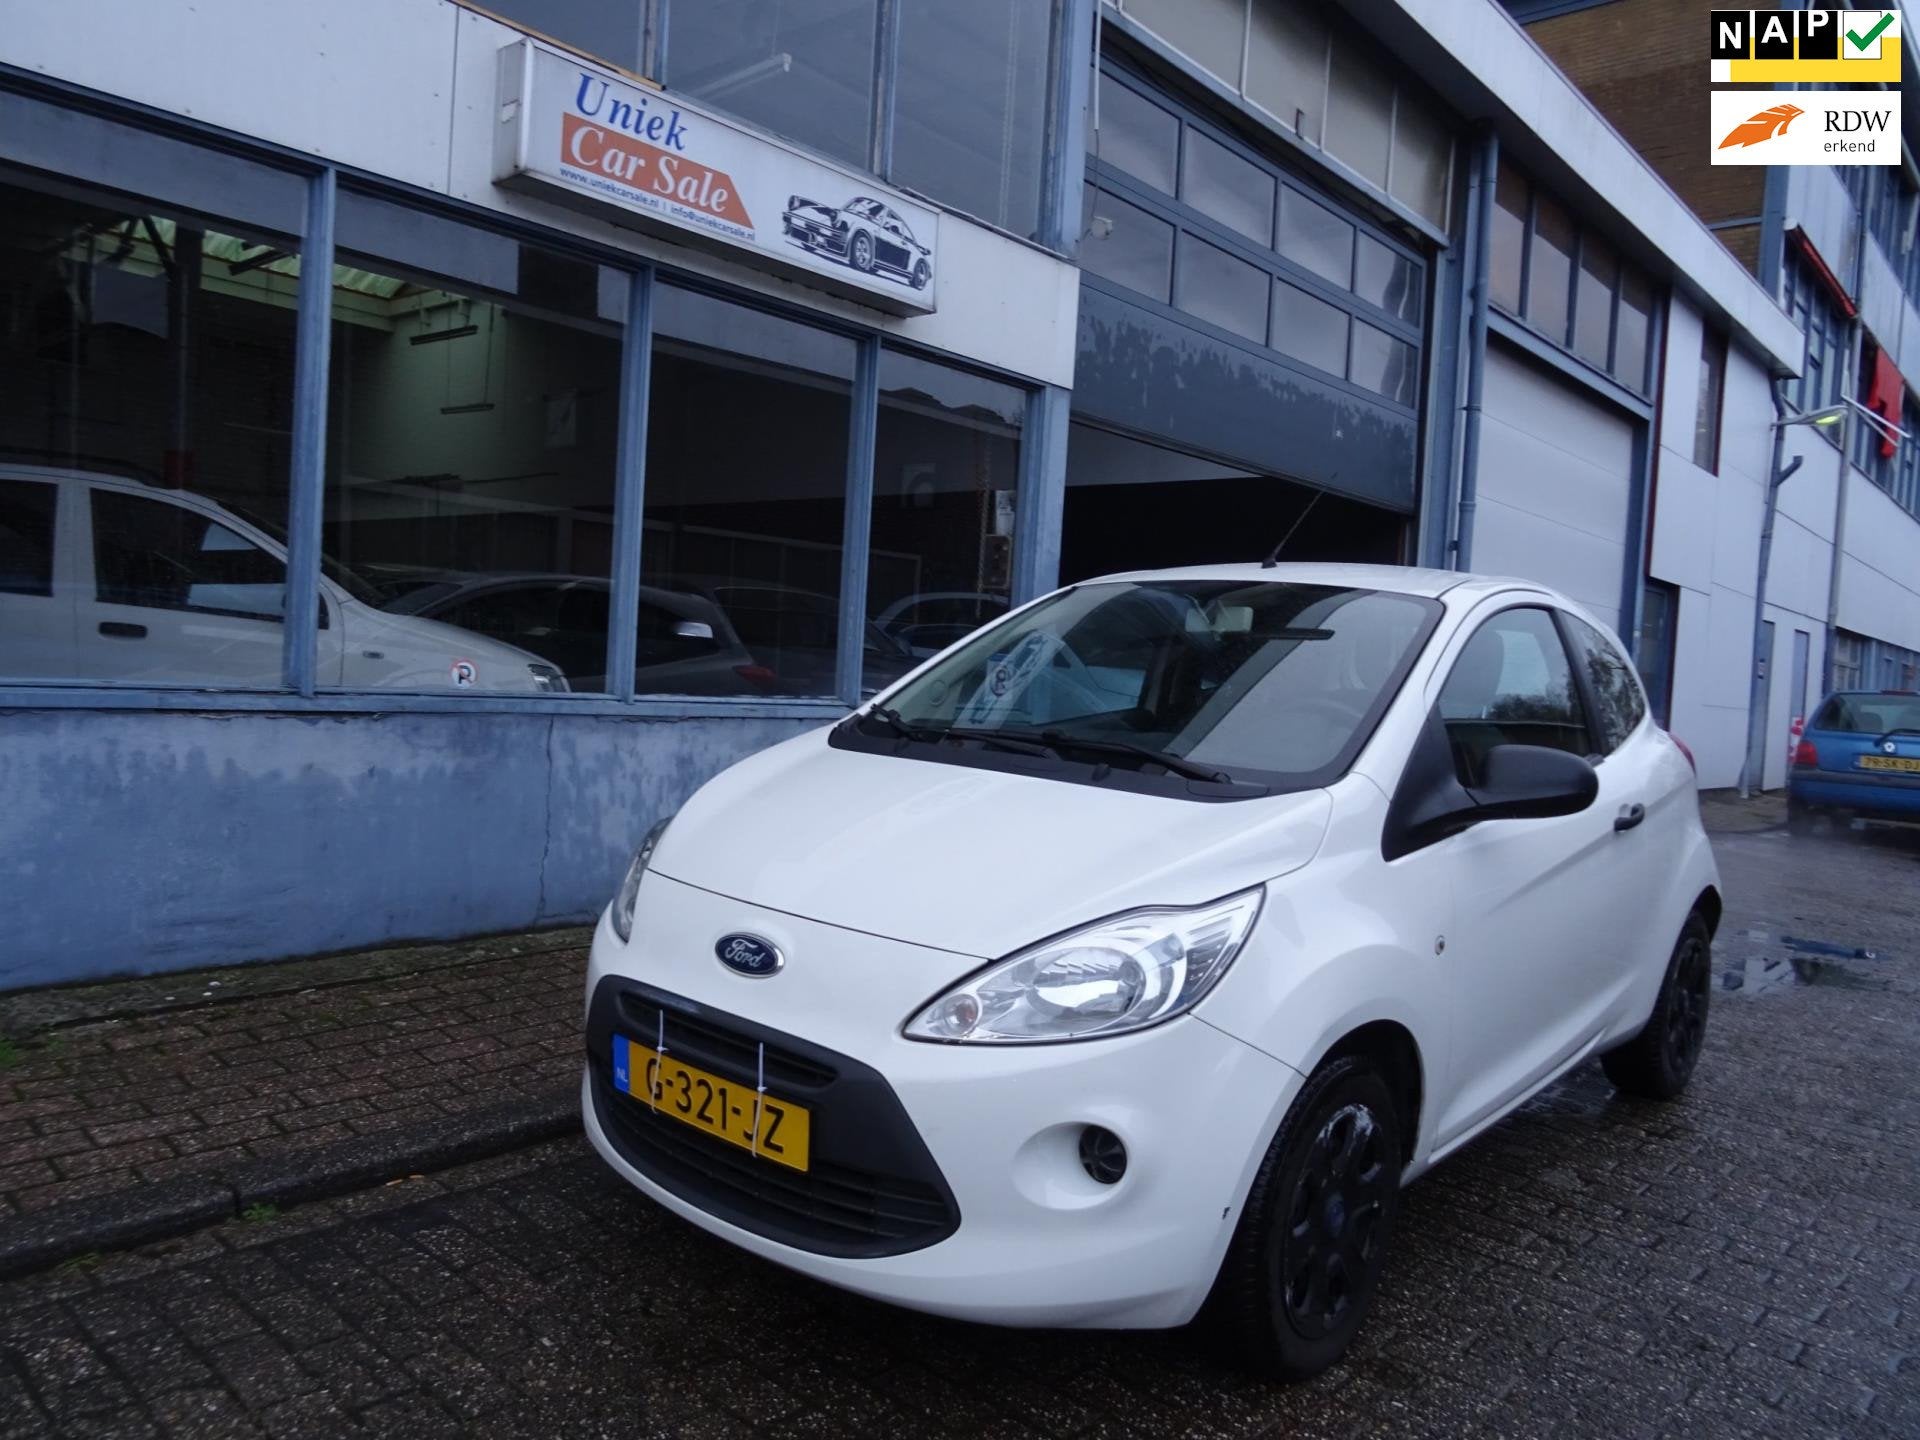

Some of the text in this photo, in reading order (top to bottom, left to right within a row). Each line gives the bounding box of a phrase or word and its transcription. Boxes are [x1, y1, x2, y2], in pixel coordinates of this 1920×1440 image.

[576, 72, 688, 151] Uniek
[560, 166, 659, 208] www.uniekcarsale.nl
[571, 125, 729, 213] Car Sale
[725, 939, 766, 967] Ford
[646, 1057, 785, 1154] G-321-JZ
